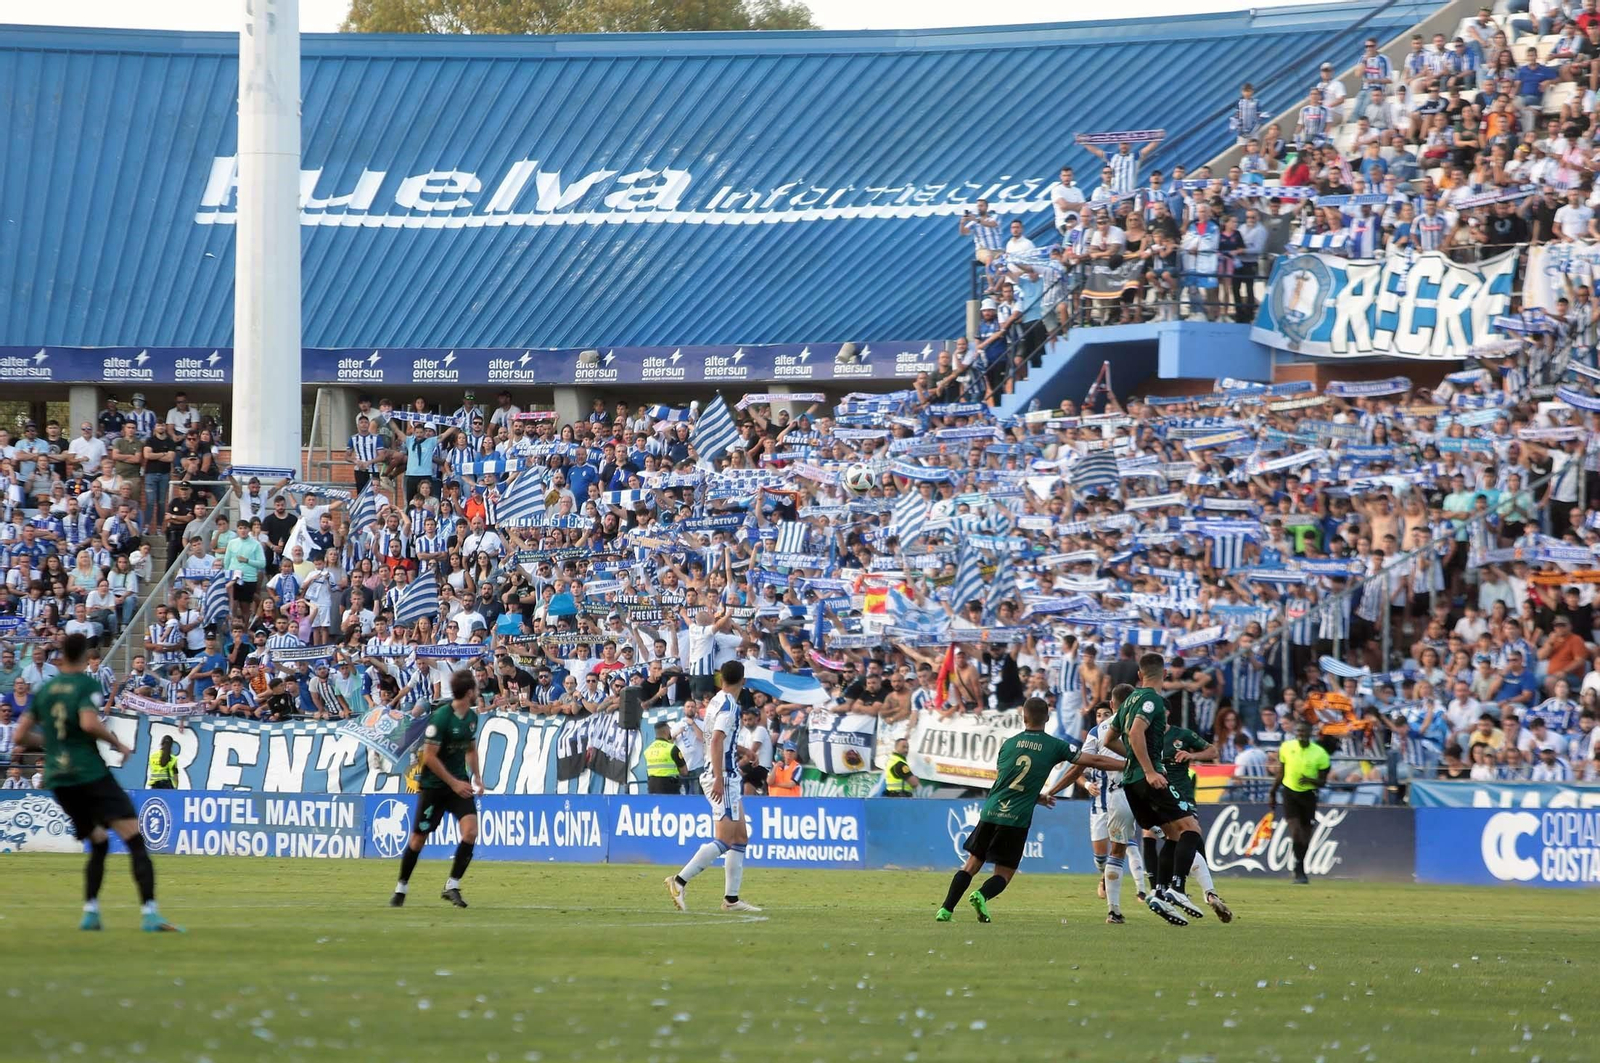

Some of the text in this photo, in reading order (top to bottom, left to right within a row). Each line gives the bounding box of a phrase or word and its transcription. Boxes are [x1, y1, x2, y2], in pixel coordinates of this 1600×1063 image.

[1332, 254, 1513, 357] RECRE
[0, 357, 30, 367] alter
[103, 357, 131, 368] alter
[175, 357, 203, 368] alter
[338, 358, 364, 368] alter
[642, 356, 666, 367] alter
[704, 355, 729, 366] alter
[774, 355, 797, 366] alter
[896, 352, 918, 363] alter
[413, 358, 439, 369] alter
[488, 358, 514, 369] alter
[833, 364, 872, 374] enersun
[895, 363, 934, 372] enersun
[0, 367, 51, 377] enersun
[103, 368, 153, 378] enersun
[175, 368, 224, 378] enersun
[338, 368, 383, 378] enersun
[413, 369, 458, 378] enersun
[488, 369, 534, 378] enersun
[575, 369, 617, 378] enersun
[642, 367, 685, 377] enersun
[704, 366, 747, 376] enersun
[774, 366, 812, 375] enersun
[685, 517, 738, 528] RECREATIVO
[631, 610, 662, 621] FRENTE
[1008, 754, 1032, 793] 2
[1169, 785, 1179, 800] 6
[184, 797, 259, 824] HOTEL
[265, 795, 354, 828] MARTÍN
[424, 805, 434, 820] 4
[424, 810, 524, 846] RAIONES
[529, 811, 549, 846] LA
[616, 804, 858, 845] Autopas Huelva
[175, 828, 360, 859] ALONSO PINZÓN
[745, 844, 859, 862] TU FRANQUICIA
